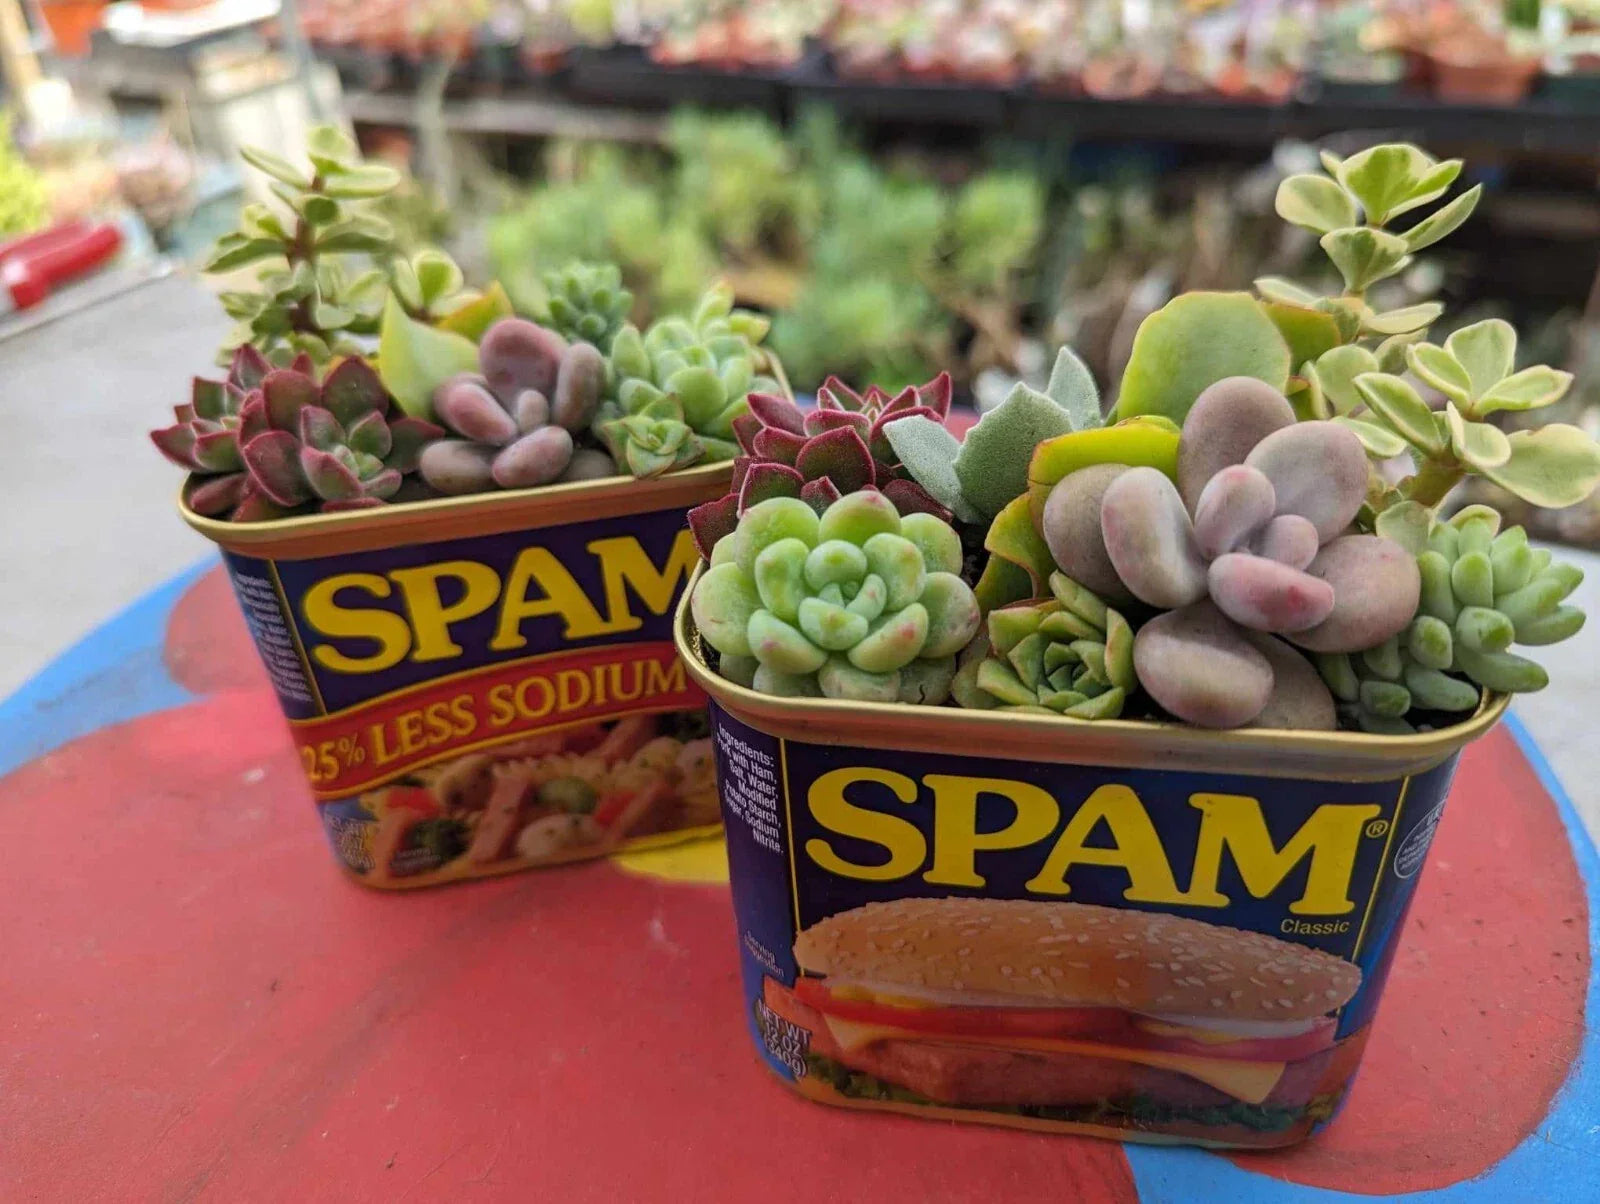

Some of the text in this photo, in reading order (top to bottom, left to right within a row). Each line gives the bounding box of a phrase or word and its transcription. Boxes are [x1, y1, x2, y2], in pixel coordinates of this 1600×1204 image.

[304, 529, 692, 674] SPAM
[302, 658, 688, 782] 25% LESS SODIUM
[719, 722, 775, 768] Ingredients:
[732, 749, 750, 771] with
[750, 760, 777, 785] Ham,
[738, 779, 777, 812] Modified
[747, 771, 779, 800] Water,
[744, 809, 780, 839] Sodium
[747, 799, 782, 828] Starch,
[1280, 918, 1350, 935] Classic
[758, 998, 812, 1047] NET WT
[782, 1034, 801, 1056] OZ
